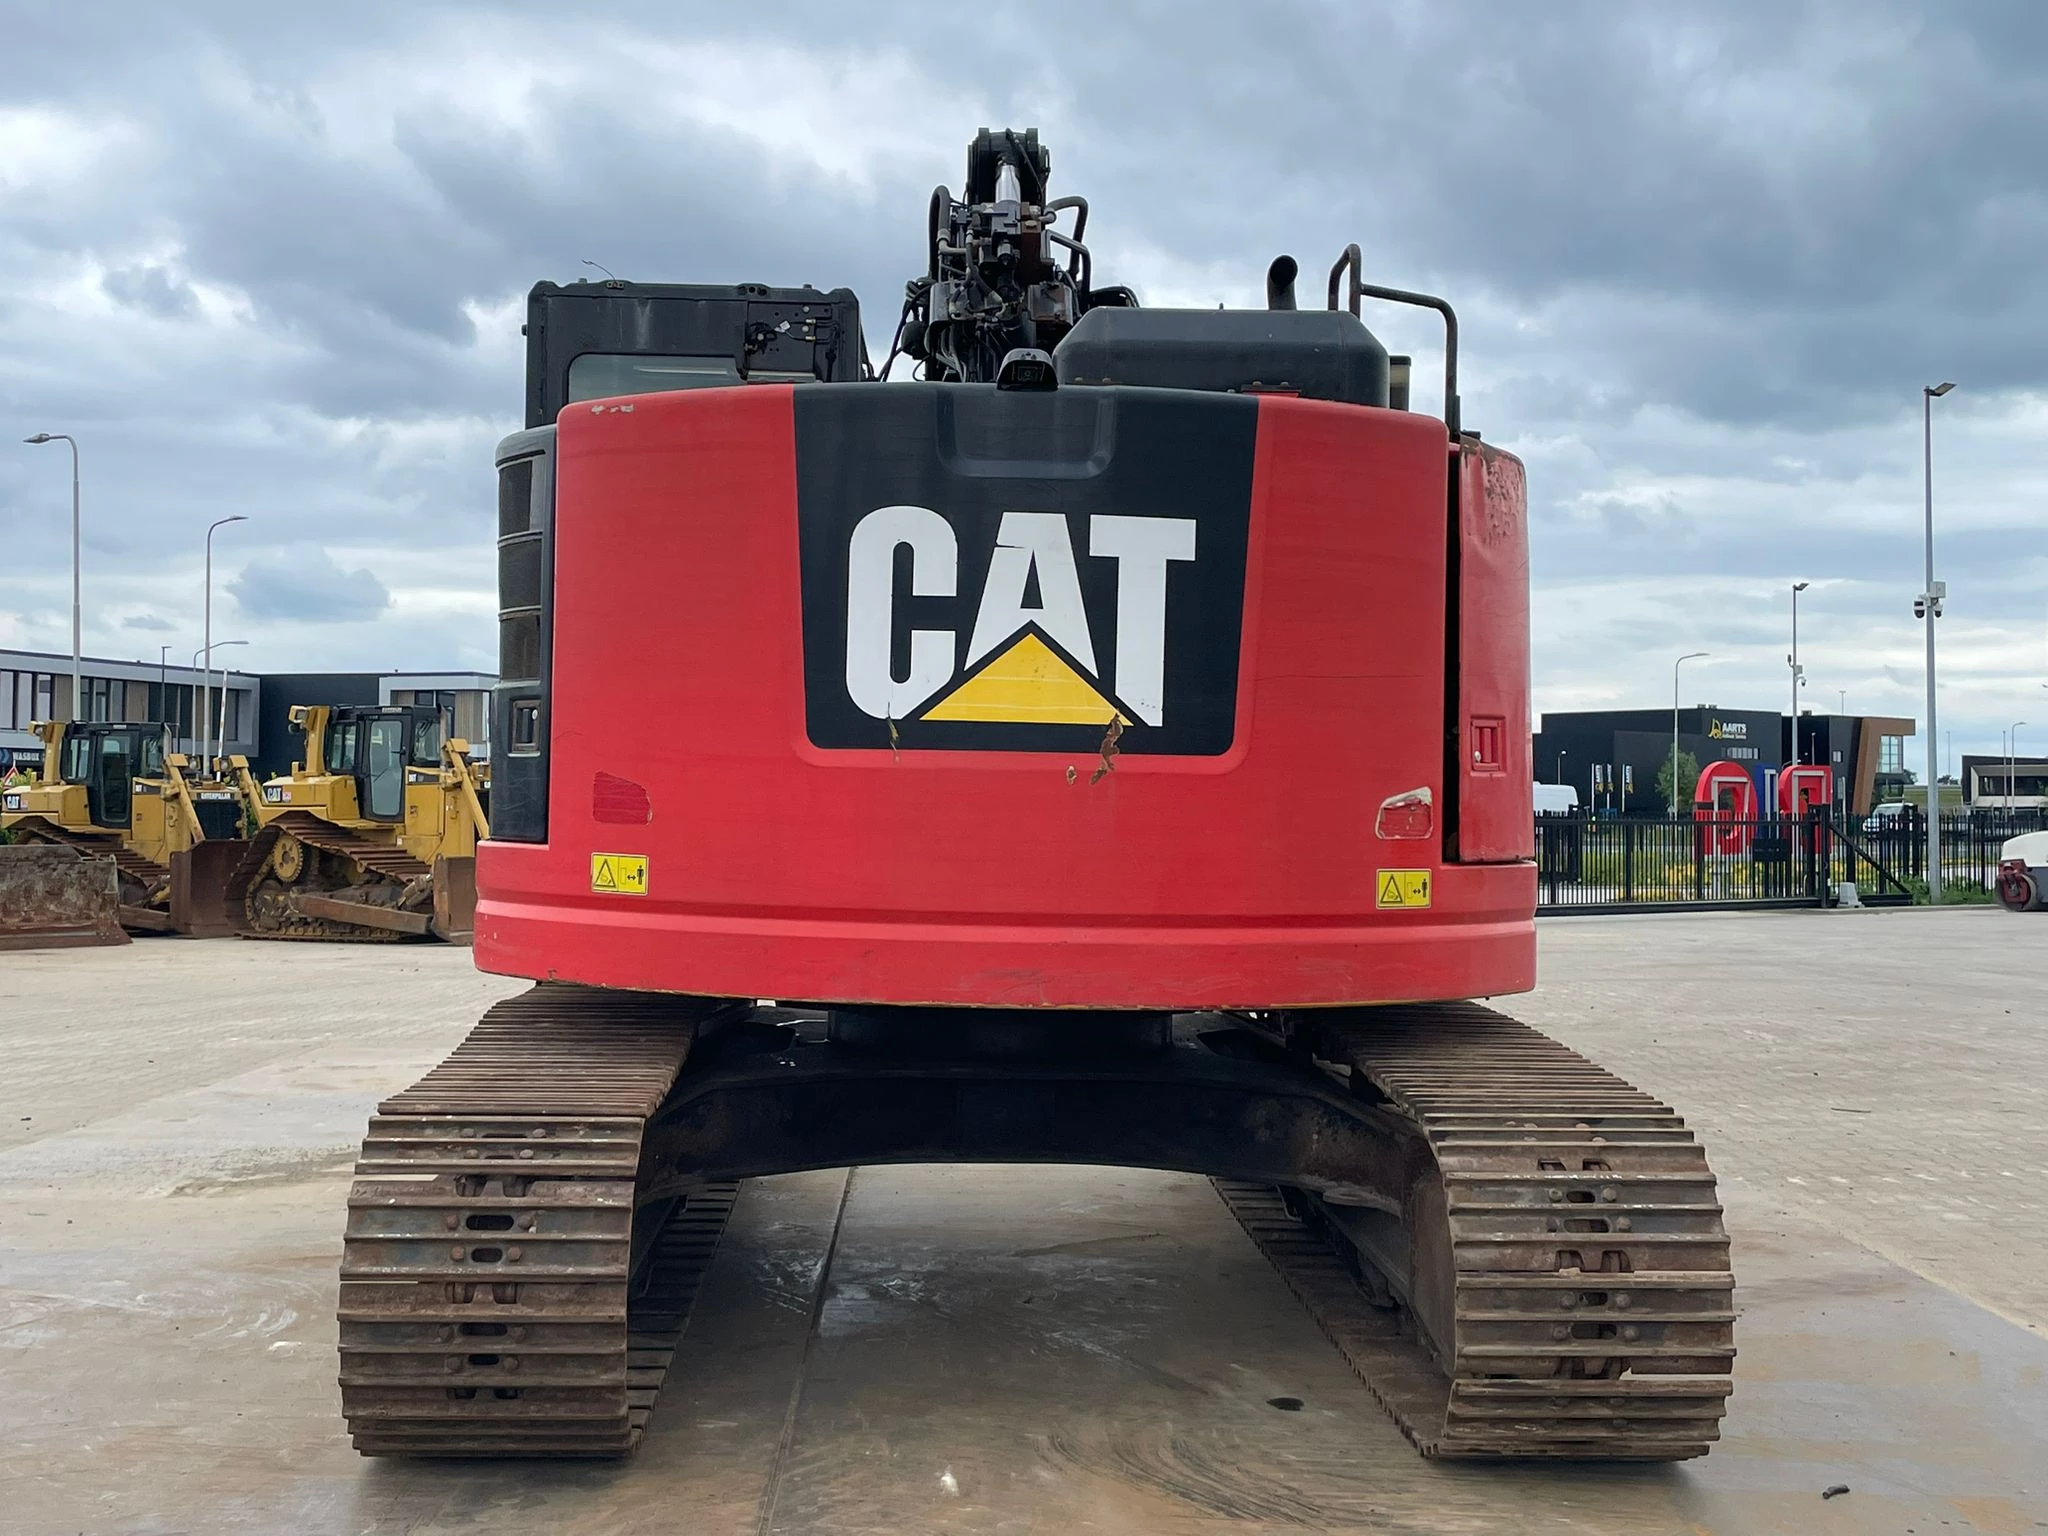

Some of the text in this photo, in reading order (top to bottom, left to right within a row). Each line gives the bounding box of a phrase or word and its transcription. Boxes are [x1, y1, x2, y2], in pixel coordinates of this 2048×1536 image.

[846, 505, 1197, 727] CAT
[1722, 722, 1747, 734] AARTS
[267, 787, 282, 802] CAT
[7, 795, 20, 809] CAT
